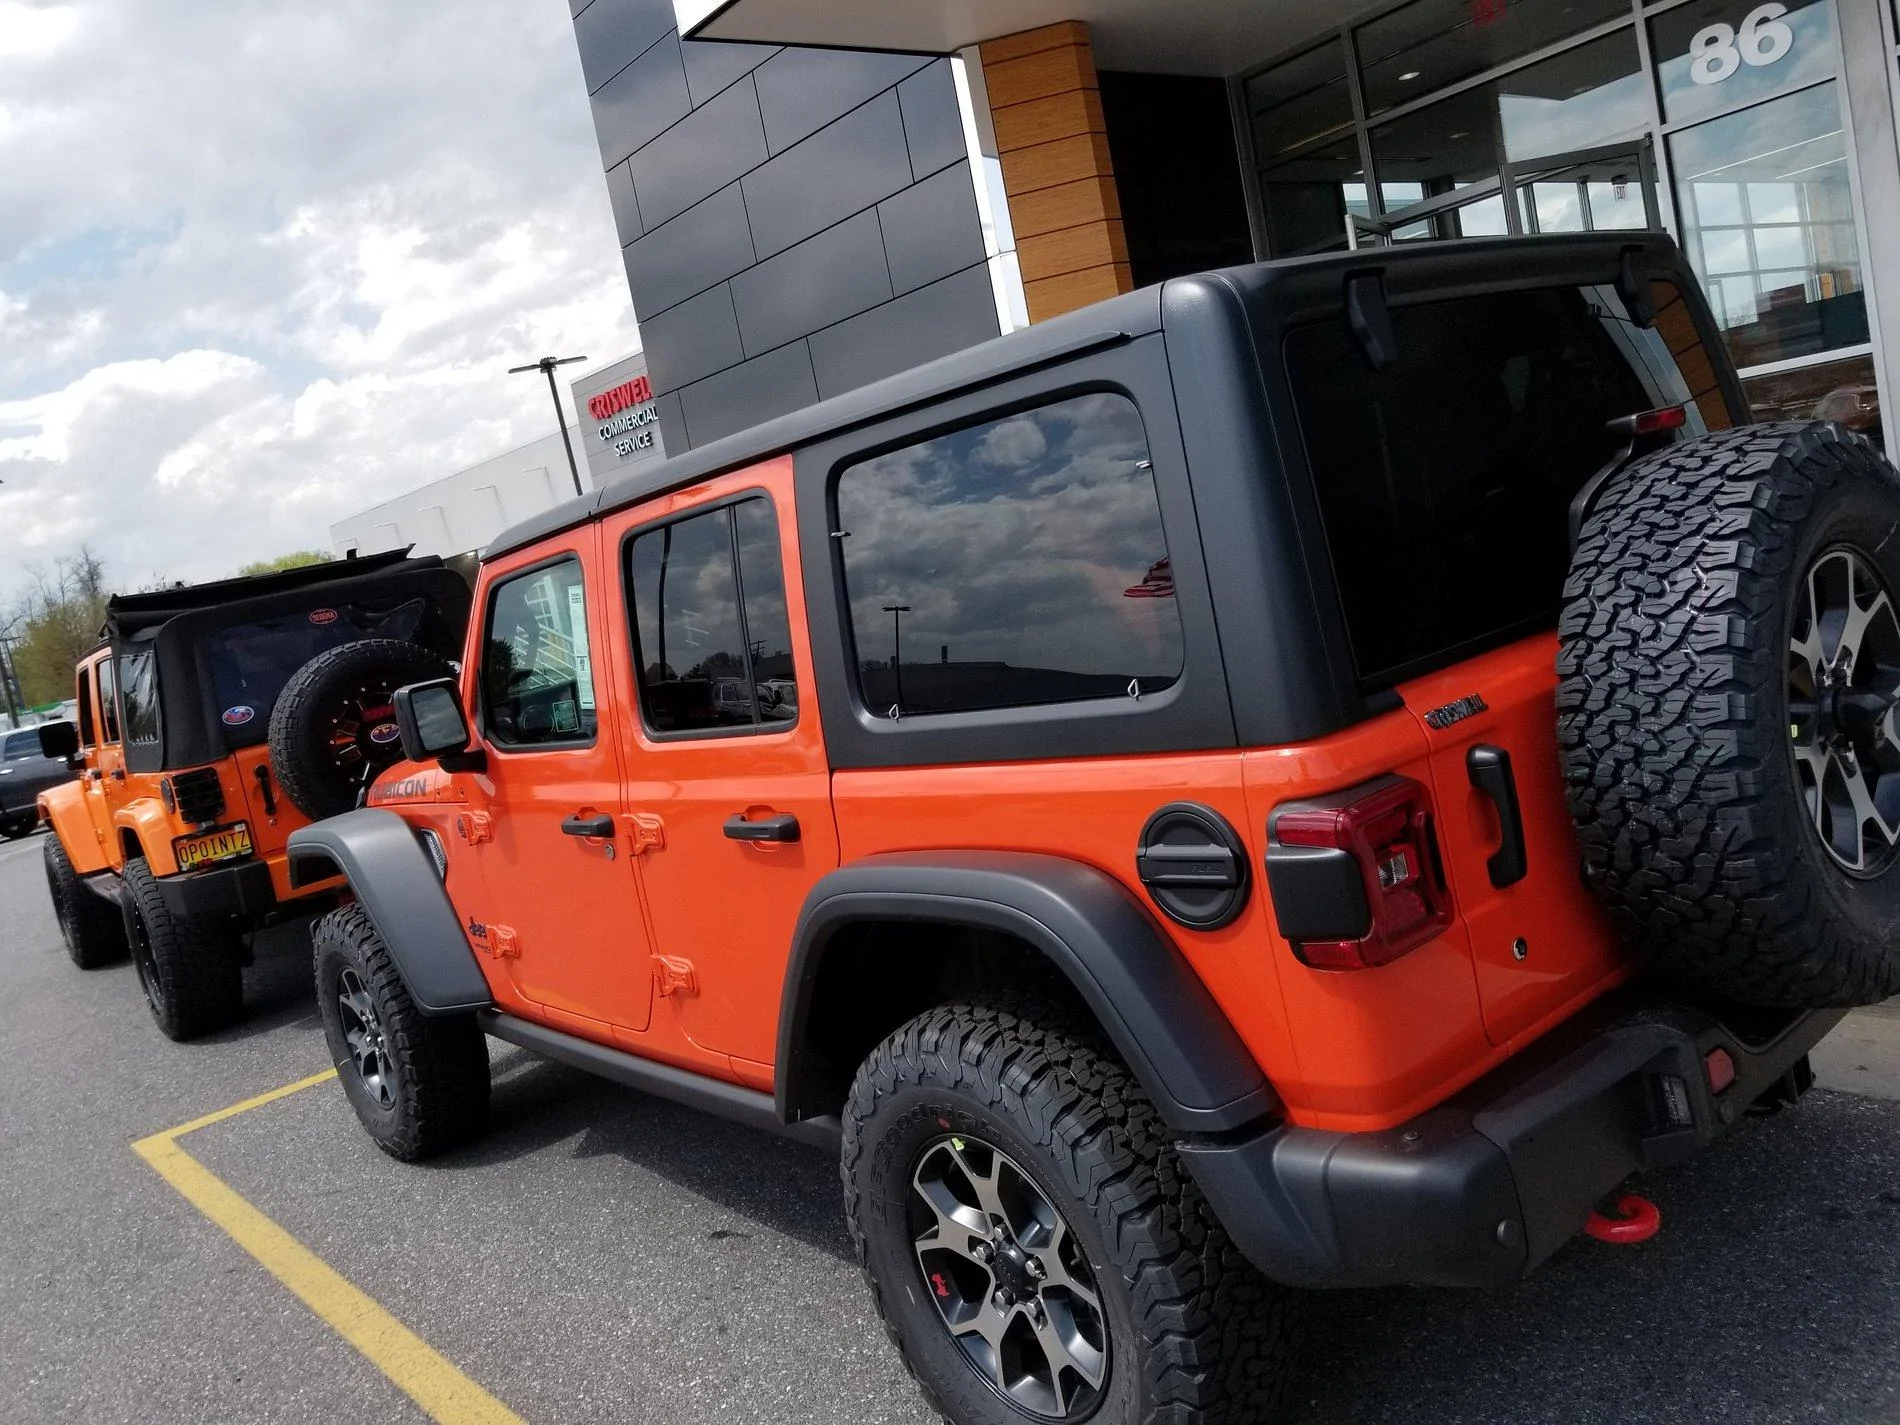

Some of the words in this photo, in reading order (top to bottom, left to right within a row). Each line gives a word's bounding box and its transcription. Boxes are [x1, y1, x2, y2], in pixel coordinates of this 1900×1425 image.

[1690, 3, 1792, 85] 86
[588, 376, 653, 419] CRISWEL
[599, 406, 658, 440] COMMERCIAL
[614, 432, 651, 456] SERVICE
[370, 778, 427, 800] RUBICON
